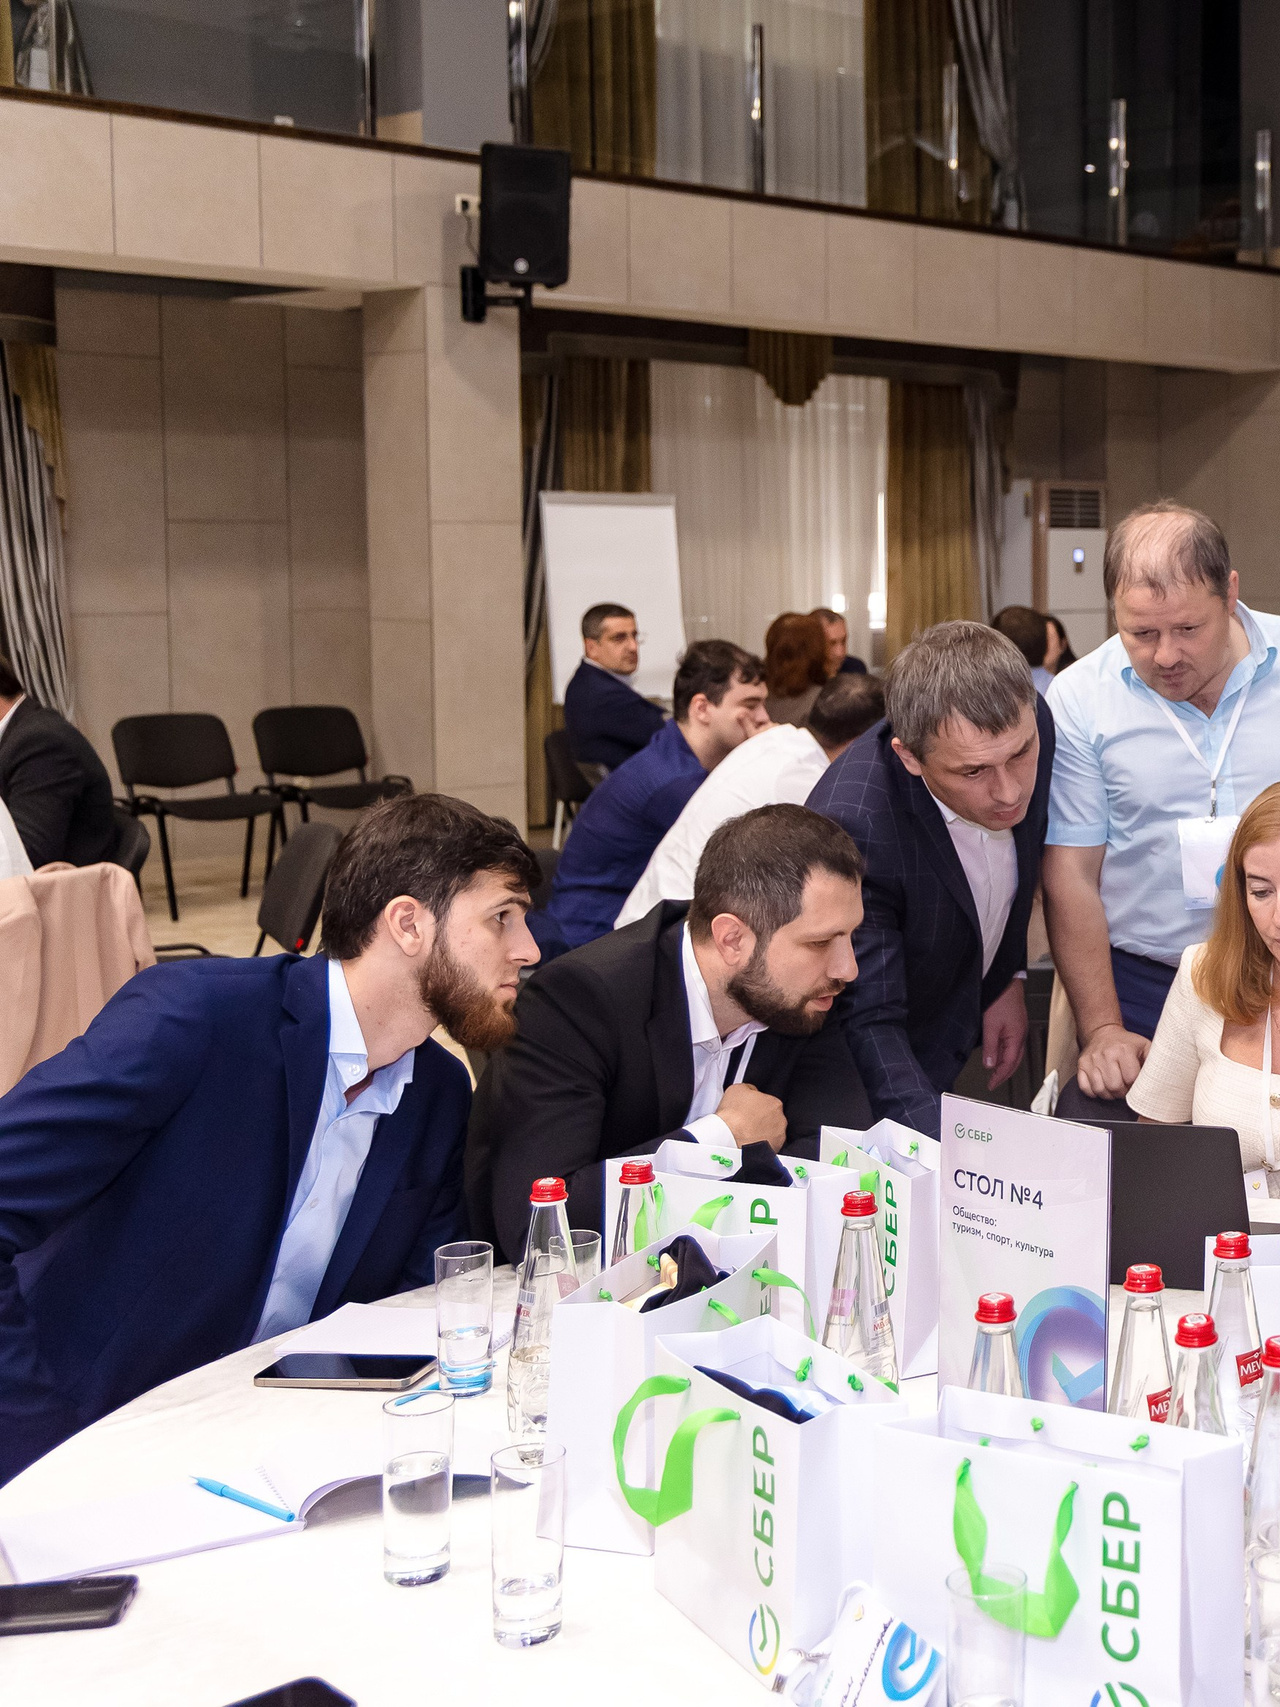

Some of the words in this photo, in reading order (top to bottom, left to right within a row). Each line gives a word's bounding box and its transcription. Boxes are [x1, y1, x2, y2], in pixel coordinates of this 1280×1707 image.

[967, 1128, 993, 1143] СБЕР
[954, 1168, 1004, 1199] СТОЛ
[1010, 1183, 1043, 1210] №4
[952, 1205, 997, 1226] Общество:
[883, 1179, 898, 1297] СБЕР
[952, 1221, 984, 1239] туризм,
[986, 1231, 1013, 1248] спорт,
[1015, 1240, 1054, 1259] культура
[752, 1425, 776, 1587] СБЕР
[1101, 1491, 1141, 1663] СБЕР
